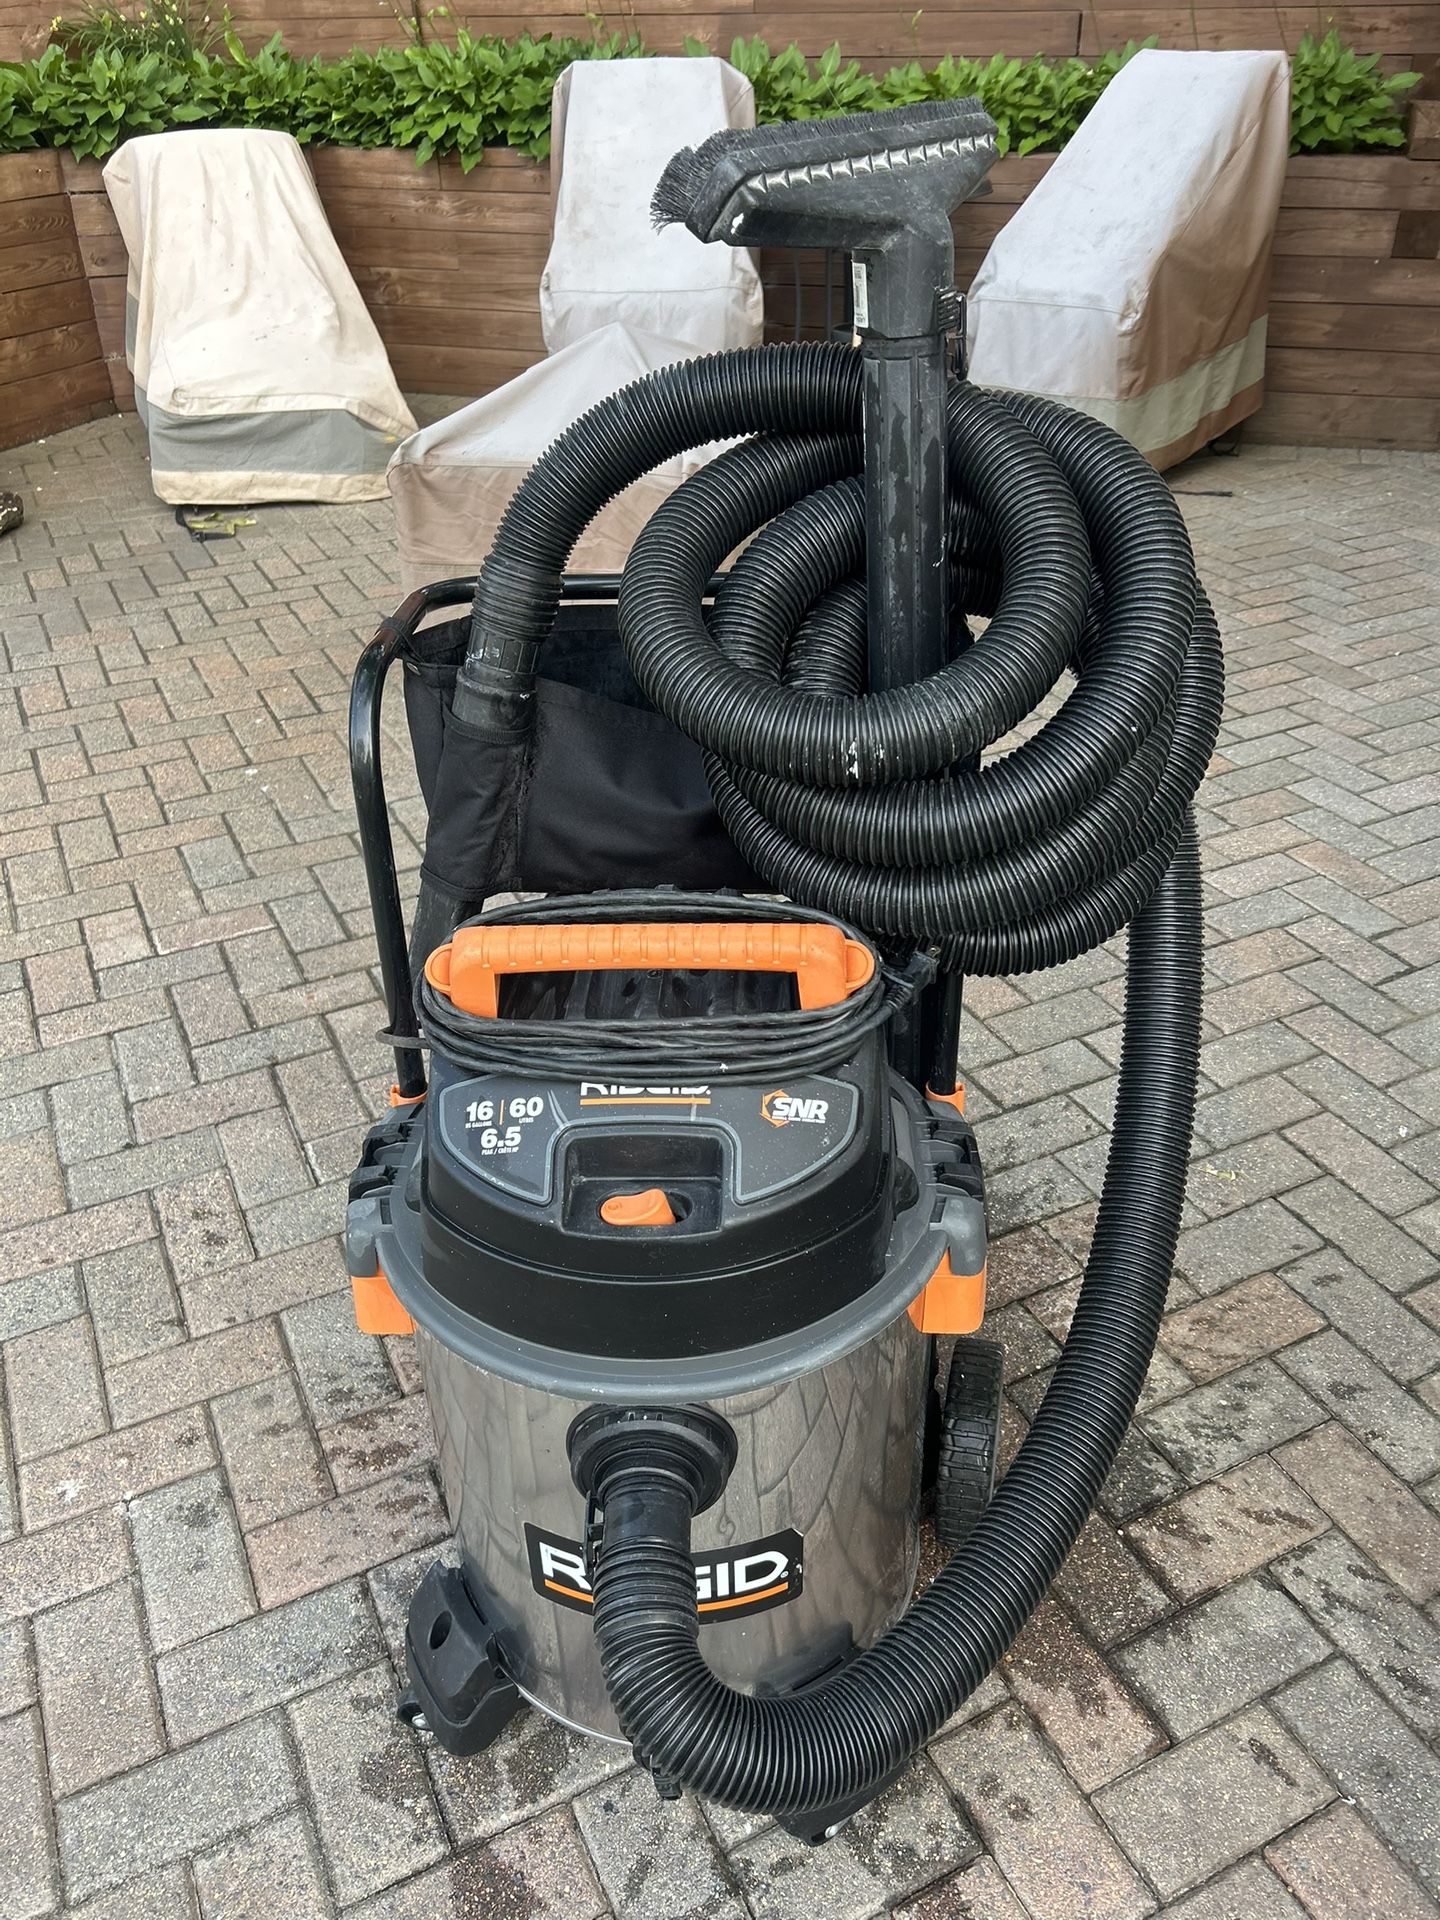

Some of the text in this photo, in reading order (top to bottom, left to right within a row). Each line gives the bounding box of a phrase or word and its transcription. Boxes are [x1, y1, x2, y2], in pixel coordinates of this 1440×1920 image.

[466, 1101, 494, 1121] 16
[509, 1096, 544, 1118] 60
[772, 1097, 829, 1120] SNR
[480, 1126, 522, 1149] 6.5
[539, 1541, 789, 1600] RID
